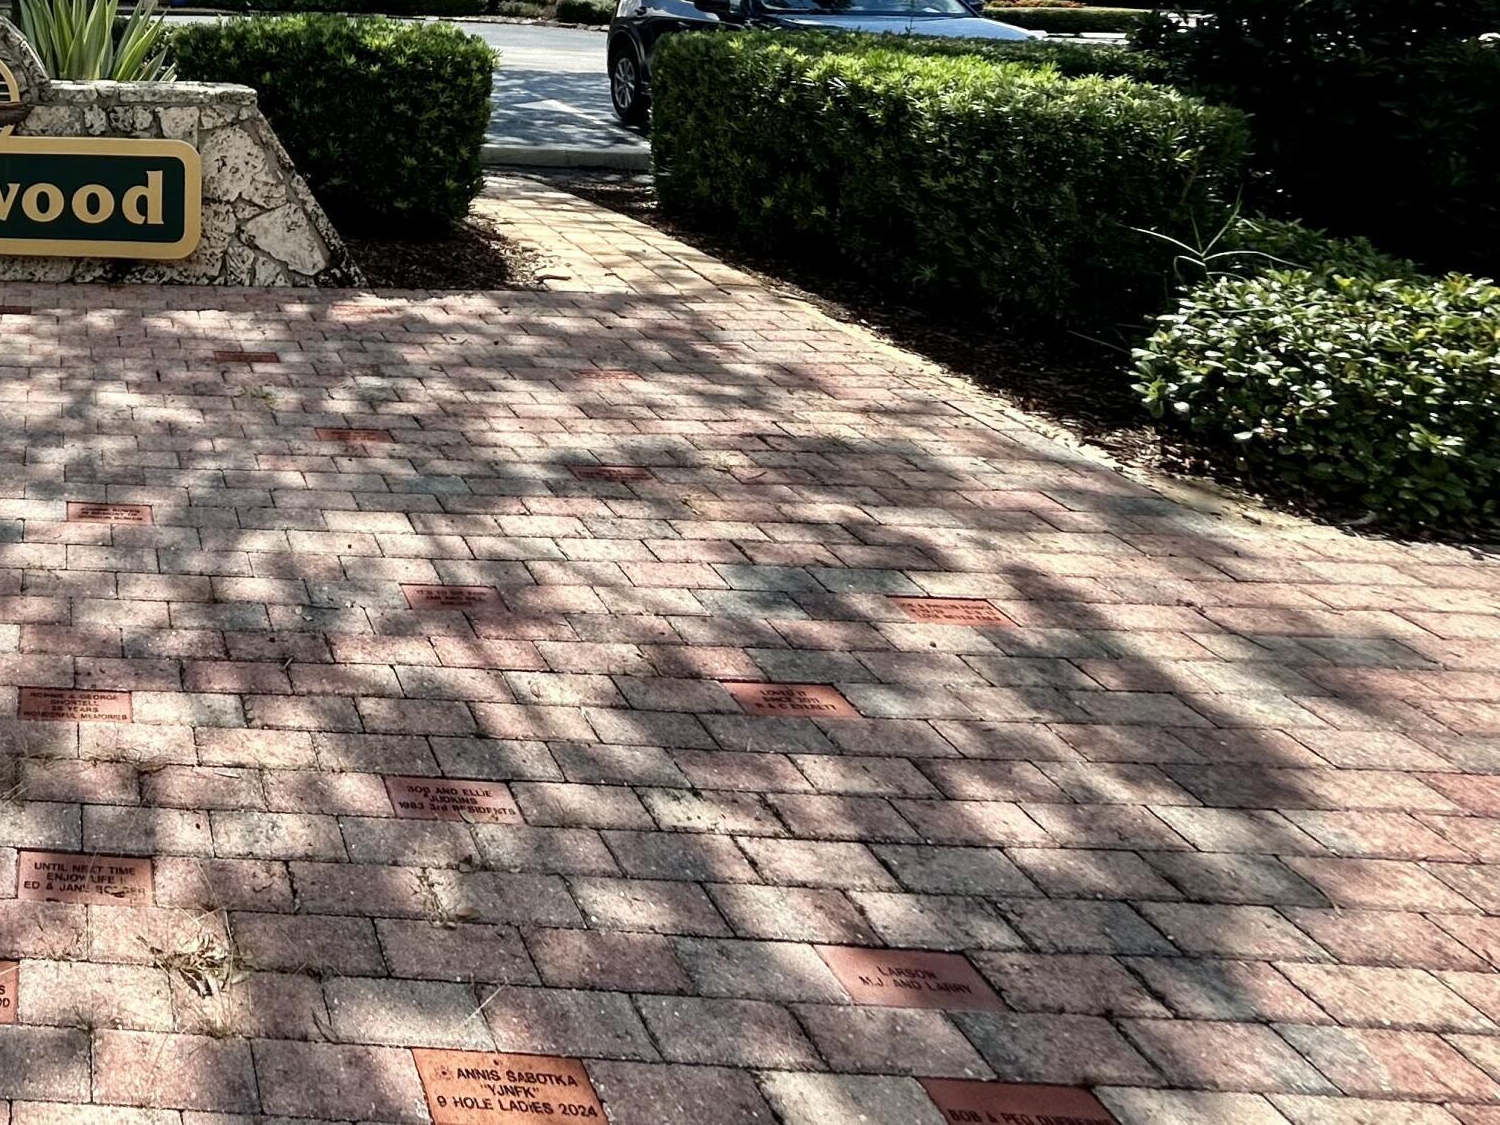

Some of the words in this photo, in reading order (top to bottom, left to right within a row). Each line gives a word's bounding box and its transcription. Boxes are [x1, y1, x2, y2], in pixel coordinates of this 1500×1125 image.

[81, 713, 127, 721] MEMORIES
[406, 786, 430, 794] BOB
[435, 787, 457, 796] AND
[462, 788, 493, 798] ELLIE
[429, 795, 478, 805] JUDKINS
[453, 805, 517, 816] RESIDENTS
[34, 862, 67, 872] UNTIL
[72, 863, 102, 874] NEXT
[108, 866, 136, 876] TIME
[46, 872, 86, 883] ENJOY
[91, 874, 115, 884] LIFE
[24, 880, 41, 890] ED
[46, 882, 54, 891] &
[876, 966, 936, 979] LARSON
[893, 978, 921, 990] AND
[923, 981, 972, 994] LARRY
[457, 1068, 501, 1082] ANNIS
[505, 1070, 579, 1086] SABOTKA
[437, 1095, 448, 1108] 9
[452, 1097, 494, 1110] HOLE
[499, 1098, 554, 1115] LADIES
[559, 1103, 598, 1118] 2024
[947, 1109, 983, 1123] BOB
